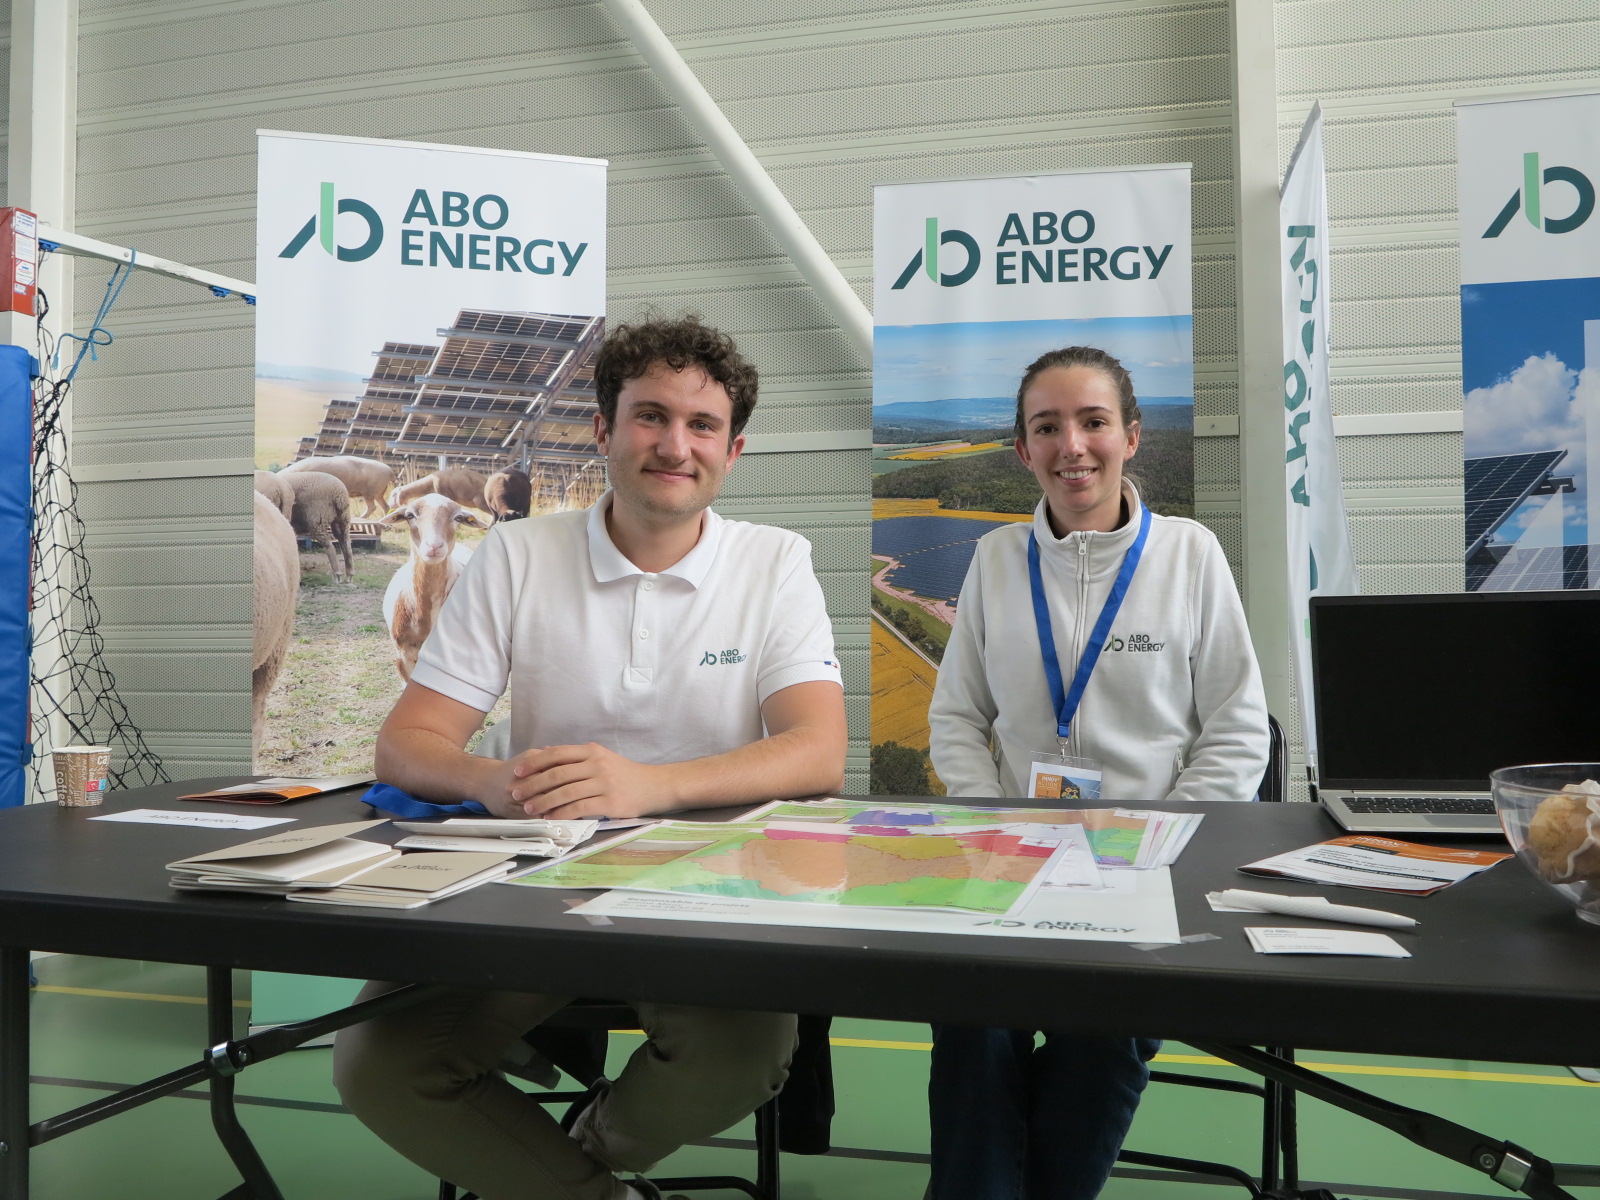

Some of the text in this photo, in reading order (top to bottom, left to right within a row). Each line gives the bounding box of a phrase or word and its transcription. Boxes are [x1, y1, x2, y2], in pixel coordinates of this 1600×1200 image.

[402, 188, 509, 230] ABO
[997, 209, 1096, 247] ABO
[401, 229, 589, 277] ENERGY
[996, 244, 1174, 285] ENERGY
[720, 648, 739, 658] ABO
[1128, 634, 1150, 644] ABO
[1128, 643, 1166, 653] ENERGY
[56, 771, 68, 807] coffee
[1034, 924, 1137, 933] ENERGY
